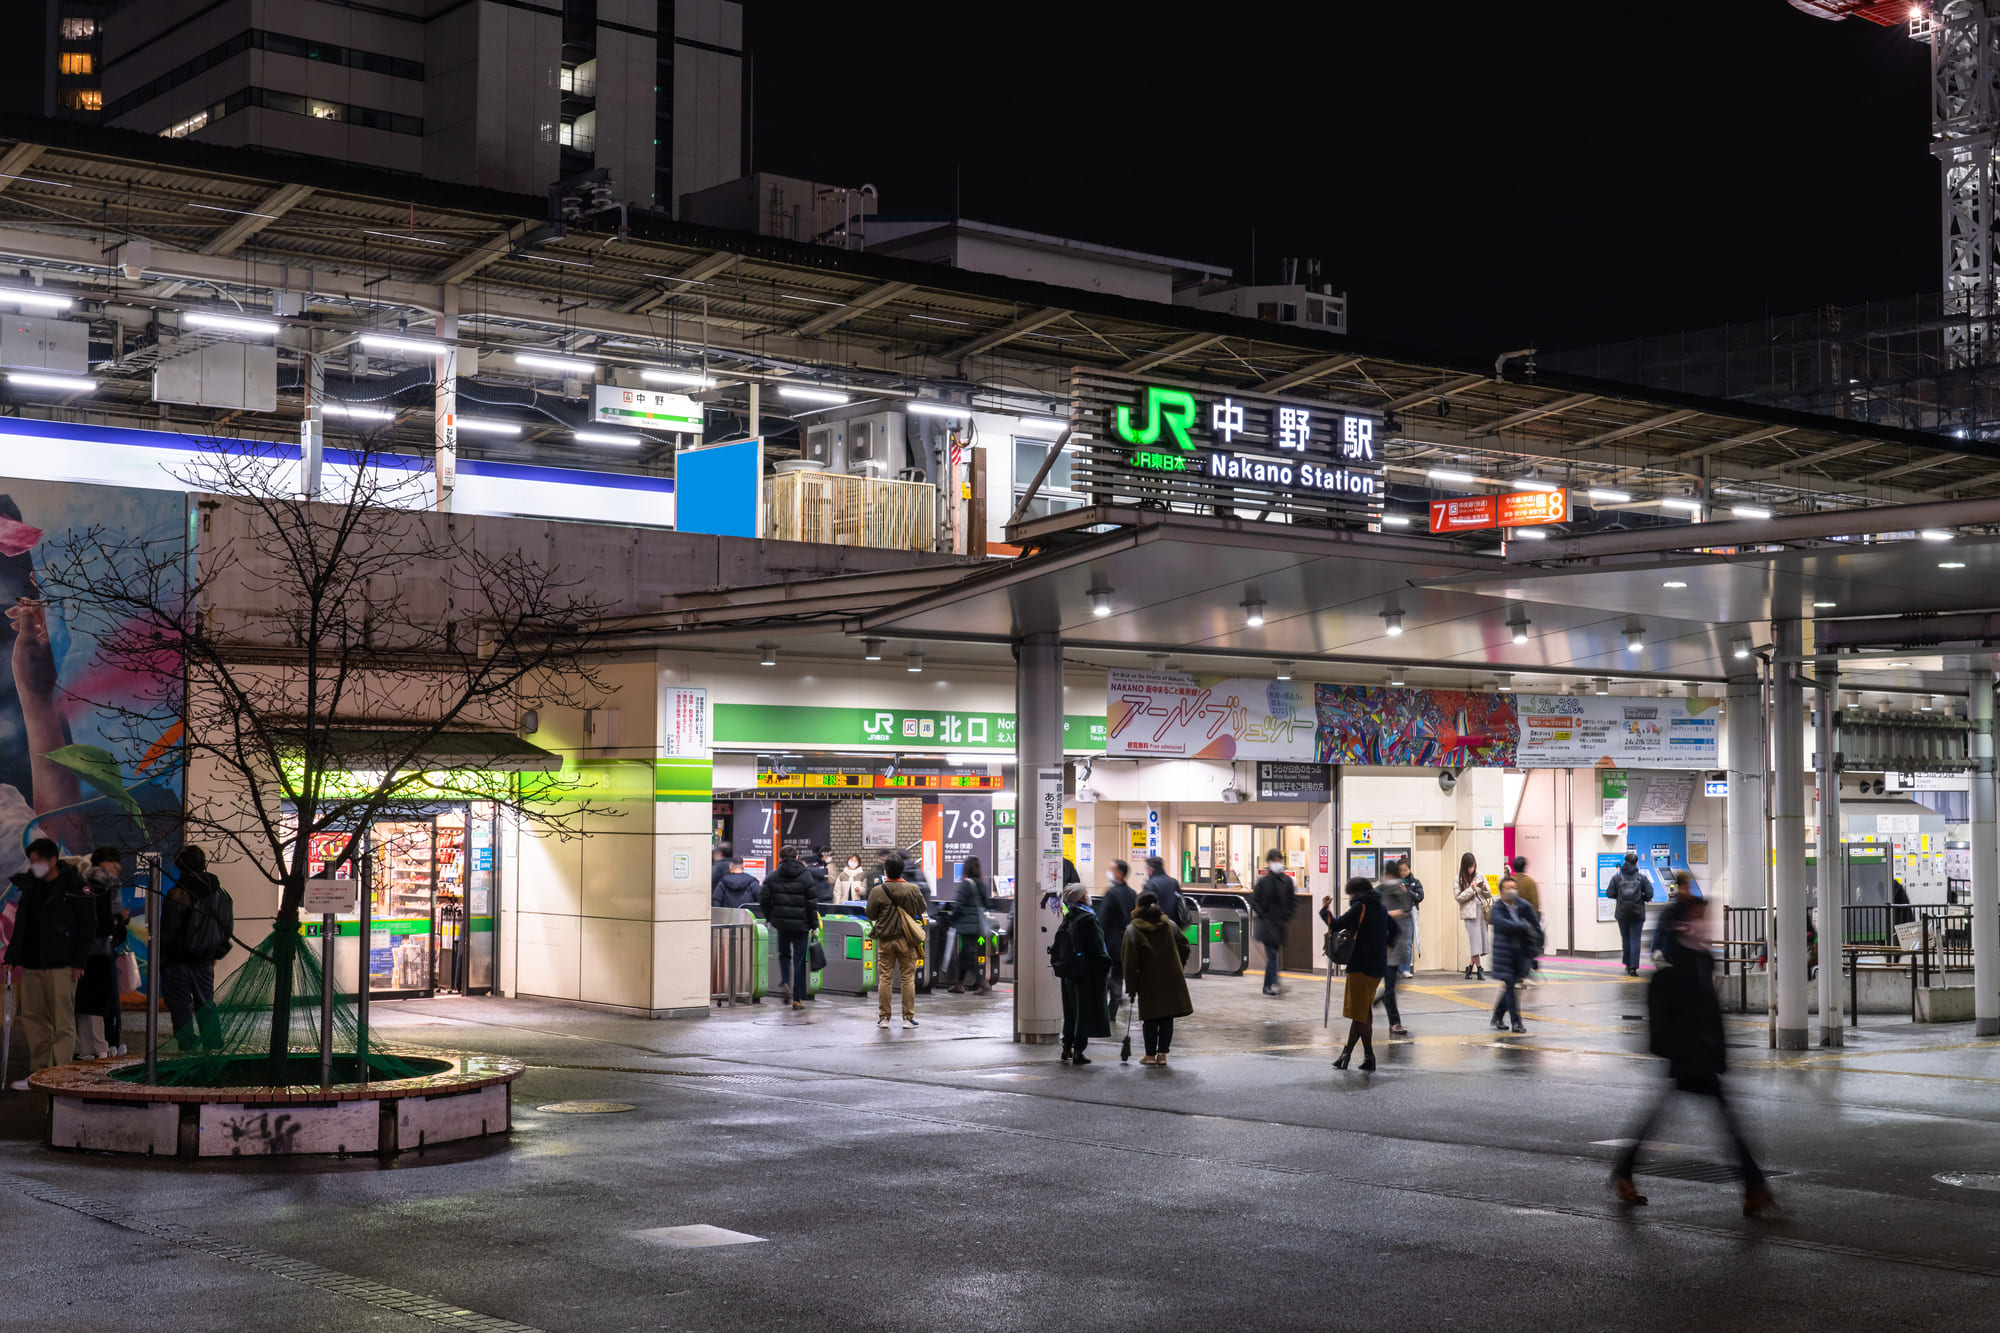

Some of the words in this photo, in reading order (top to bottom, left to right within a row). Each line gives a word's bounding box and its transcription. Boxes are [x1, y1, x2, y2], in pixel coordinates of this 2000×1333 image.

[636, 393, 665, 407] 中野
[1117, 386, 1197, 451] JR
[1212, 398, 1374, 461] 中野駅
[1130, 451, 1186, 472] JR東日本
[1211, 453, 1293, 485] Nakano
[1300, 464, 1375, 495] Station
[1433, 504, 1447, 530] 7
[1548, 492, 1564, 520] 8
[1110, 683, 1144, 693] NAKANO
[863, 712, 895, 735] JR
[939, 714, 988, 743] 北口
[1045, 792, 1055, 821] あちら
[761, 808, 772, 835] 7
[783, 808, 799, 835] 7
[864, 940, 873, 950] IC
